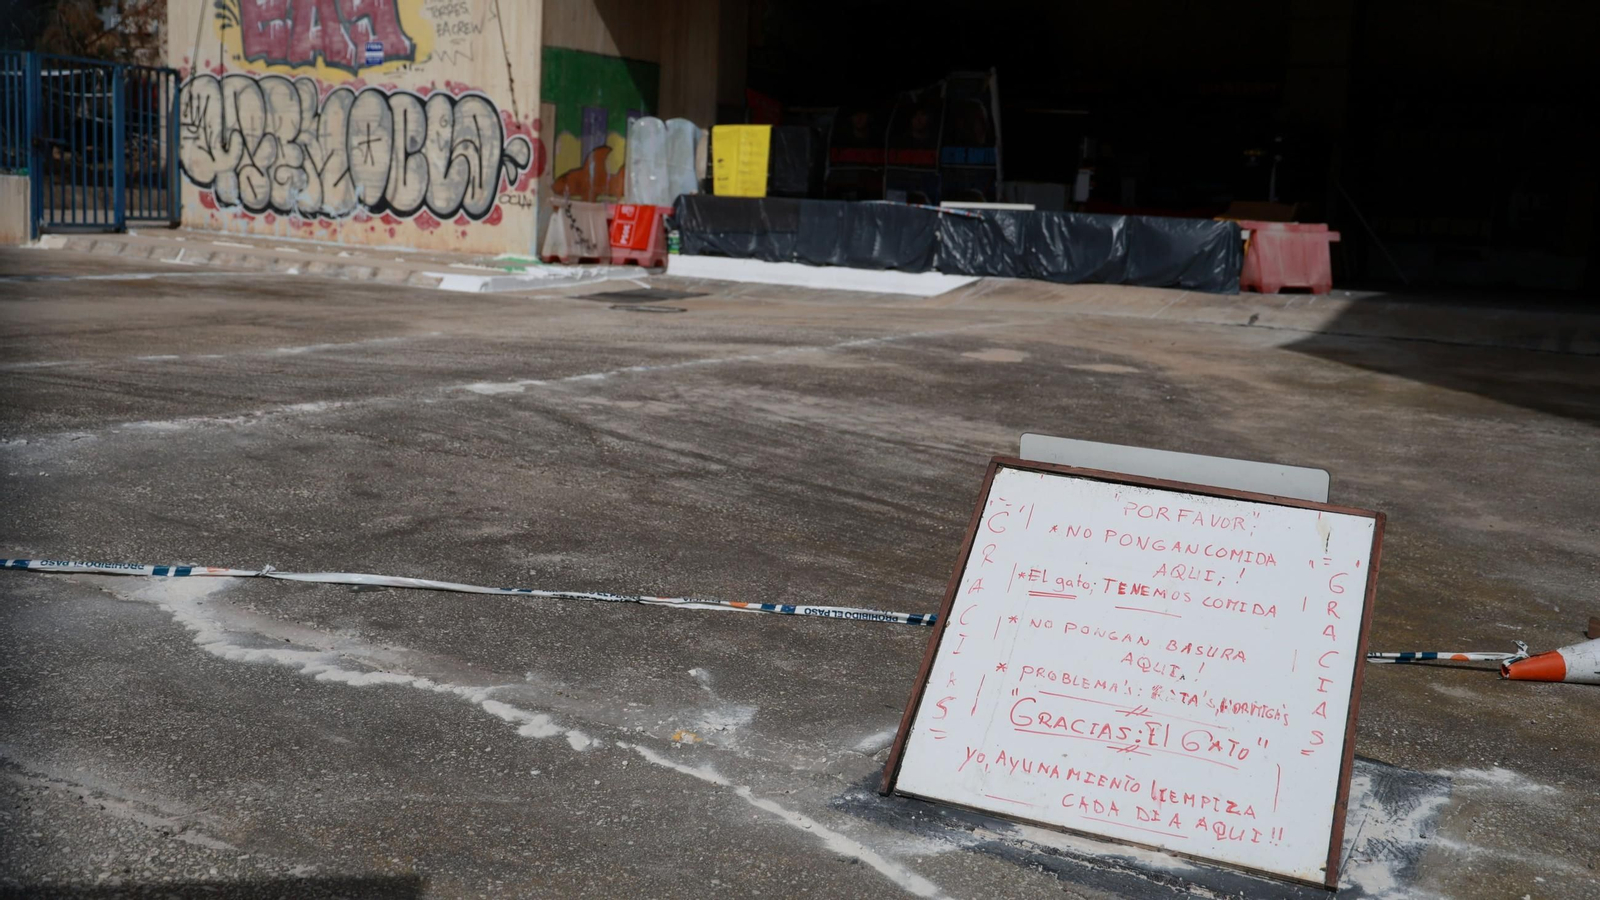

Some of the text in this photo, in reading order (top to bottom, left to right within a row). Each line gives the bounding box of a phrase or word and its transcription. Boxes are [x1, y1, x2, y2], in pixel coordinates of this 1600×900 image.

[1066, 524, 1093, 539] NO
[1103, 577, 1192, 603] TENEMOS
[1202, 595, 1278, 619] COMIDA
[804, 607, 899, 623] PROHIBIDO EL PASO
[1030, 618, 1247, 663] NO PONGAN BASURA
[995, 749, 1142, 794] AYUNAMIENTO
[1062, 793, 1120, 818] CADA
